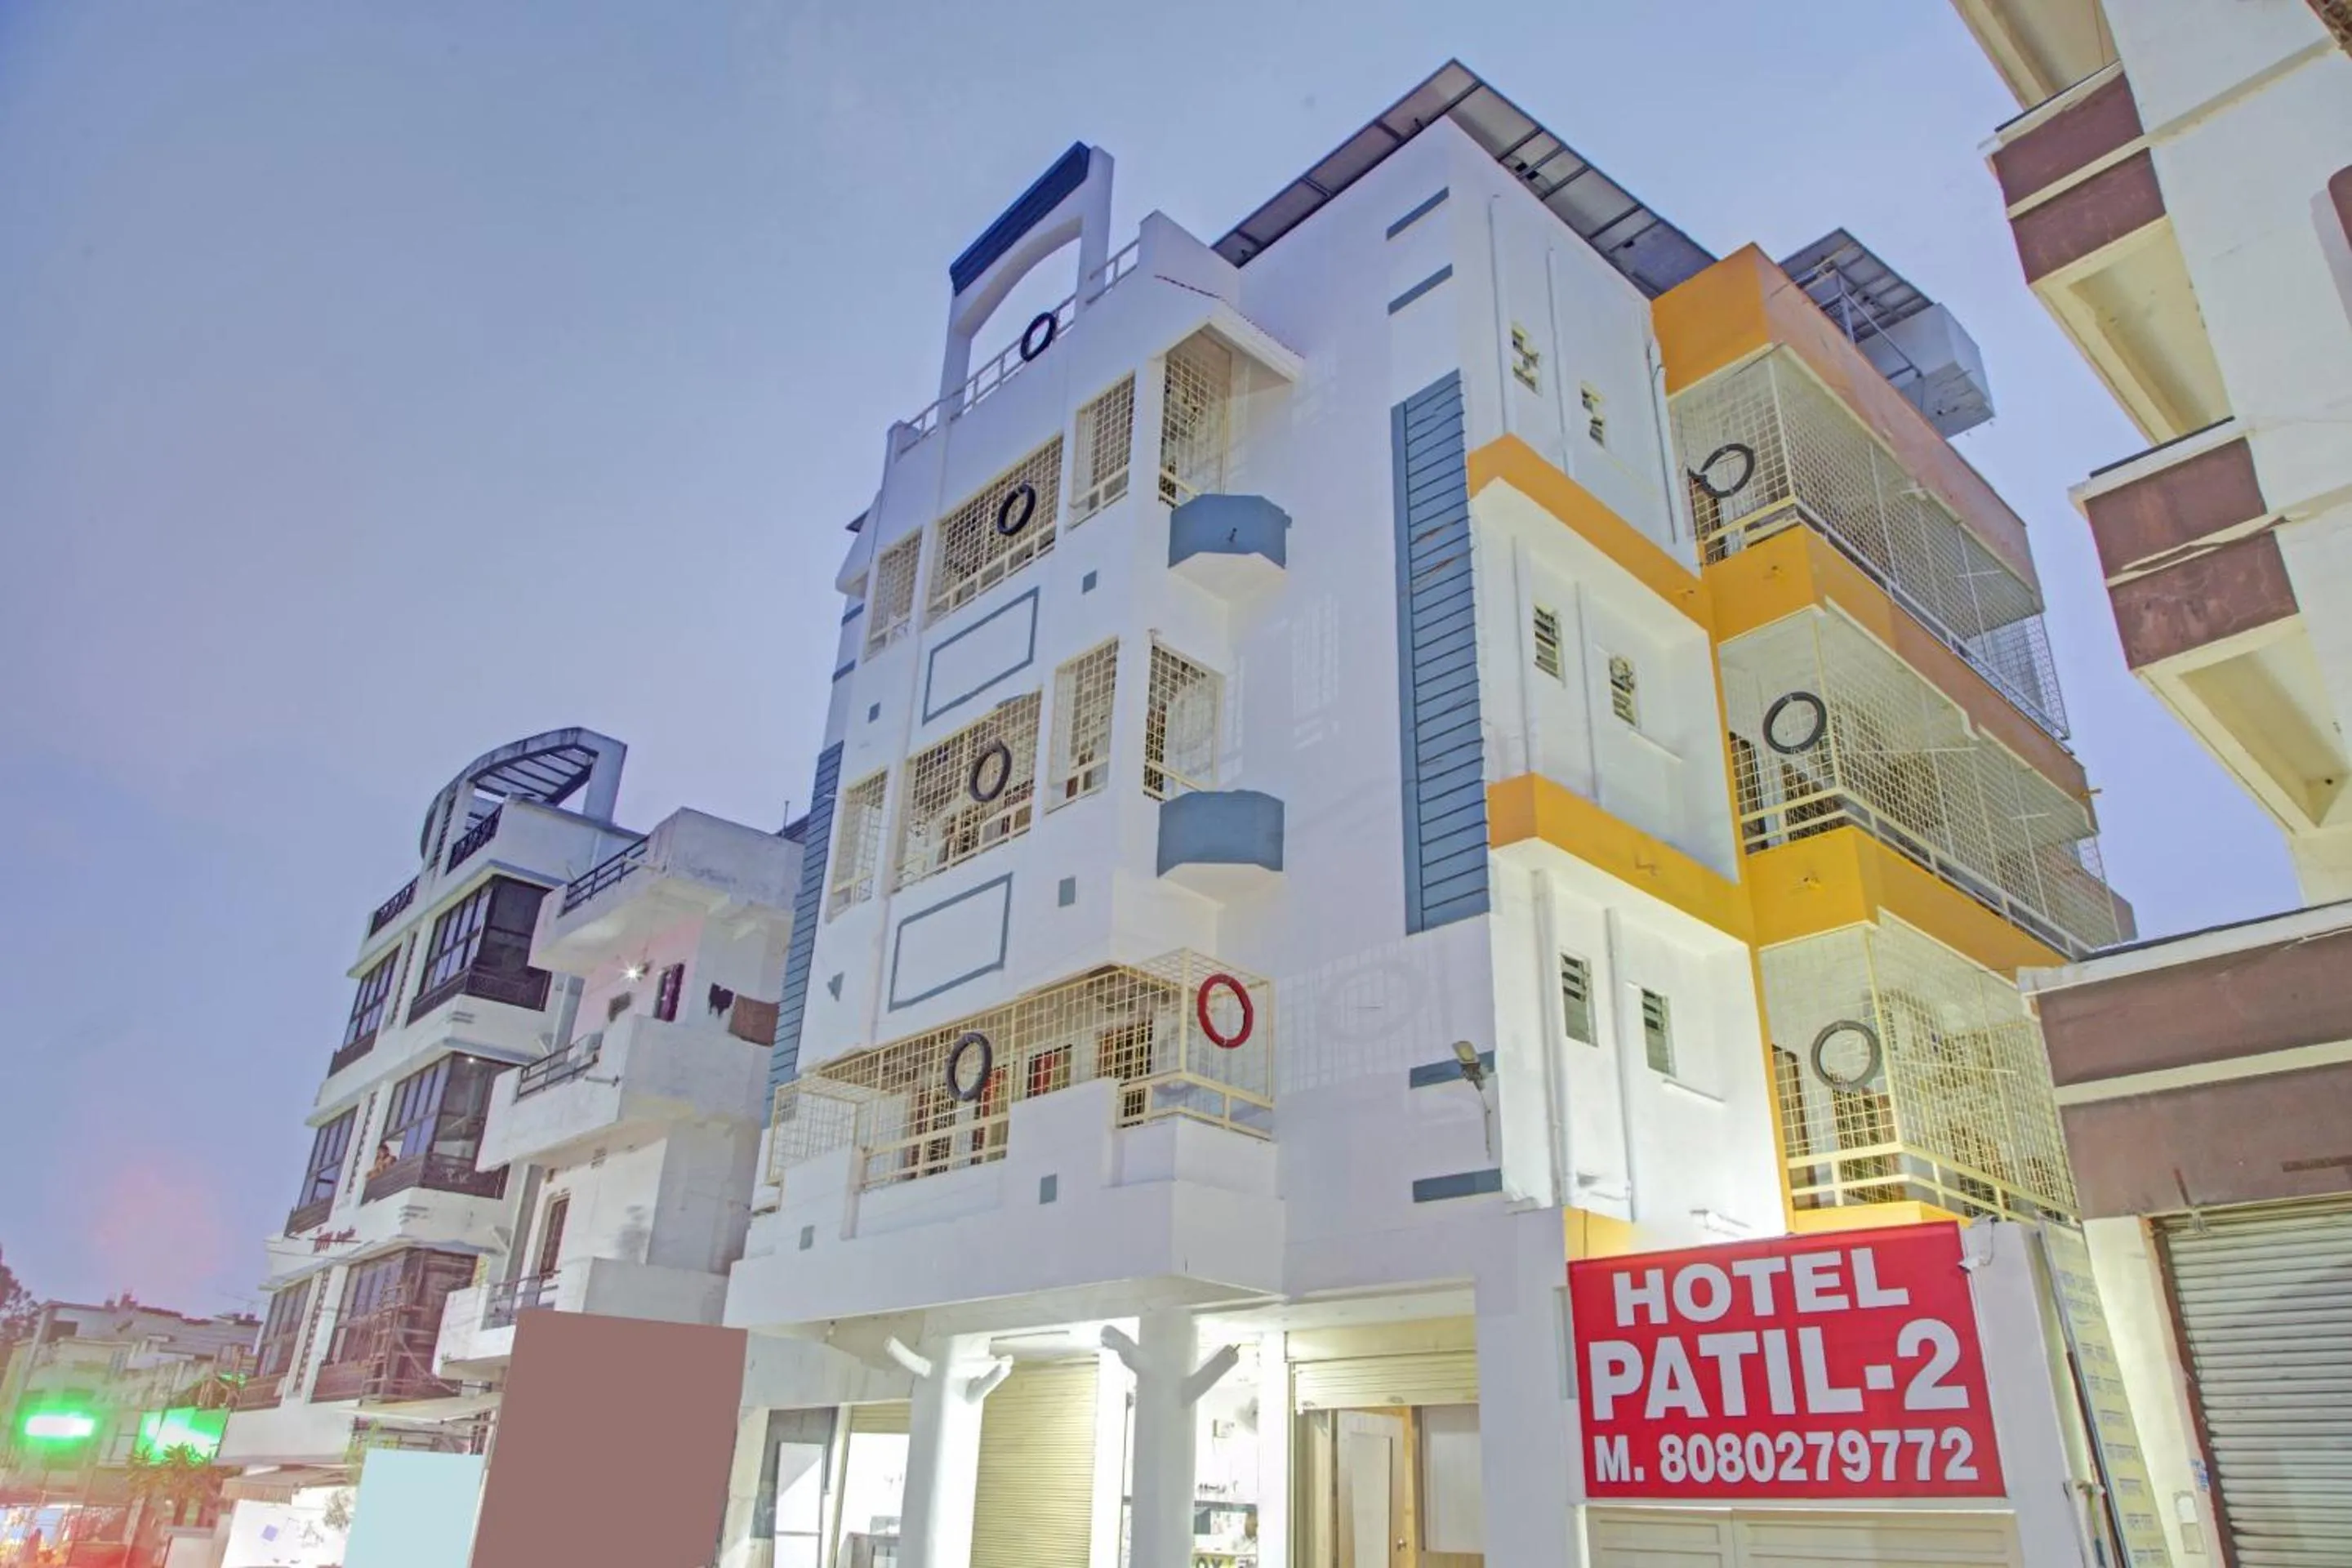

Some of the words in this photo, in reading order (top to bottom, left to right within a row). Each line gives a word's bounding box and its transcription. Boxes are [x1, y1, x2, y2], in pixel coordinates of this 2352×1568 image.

[1613, 1247, 1909, 1327] HOTEL
[1588, 1318, 1970, 1420] PATIL-2
[1594, 1435, 1644, 1482] M.
[1659, 1427, 1979, 1483] 8080279772
